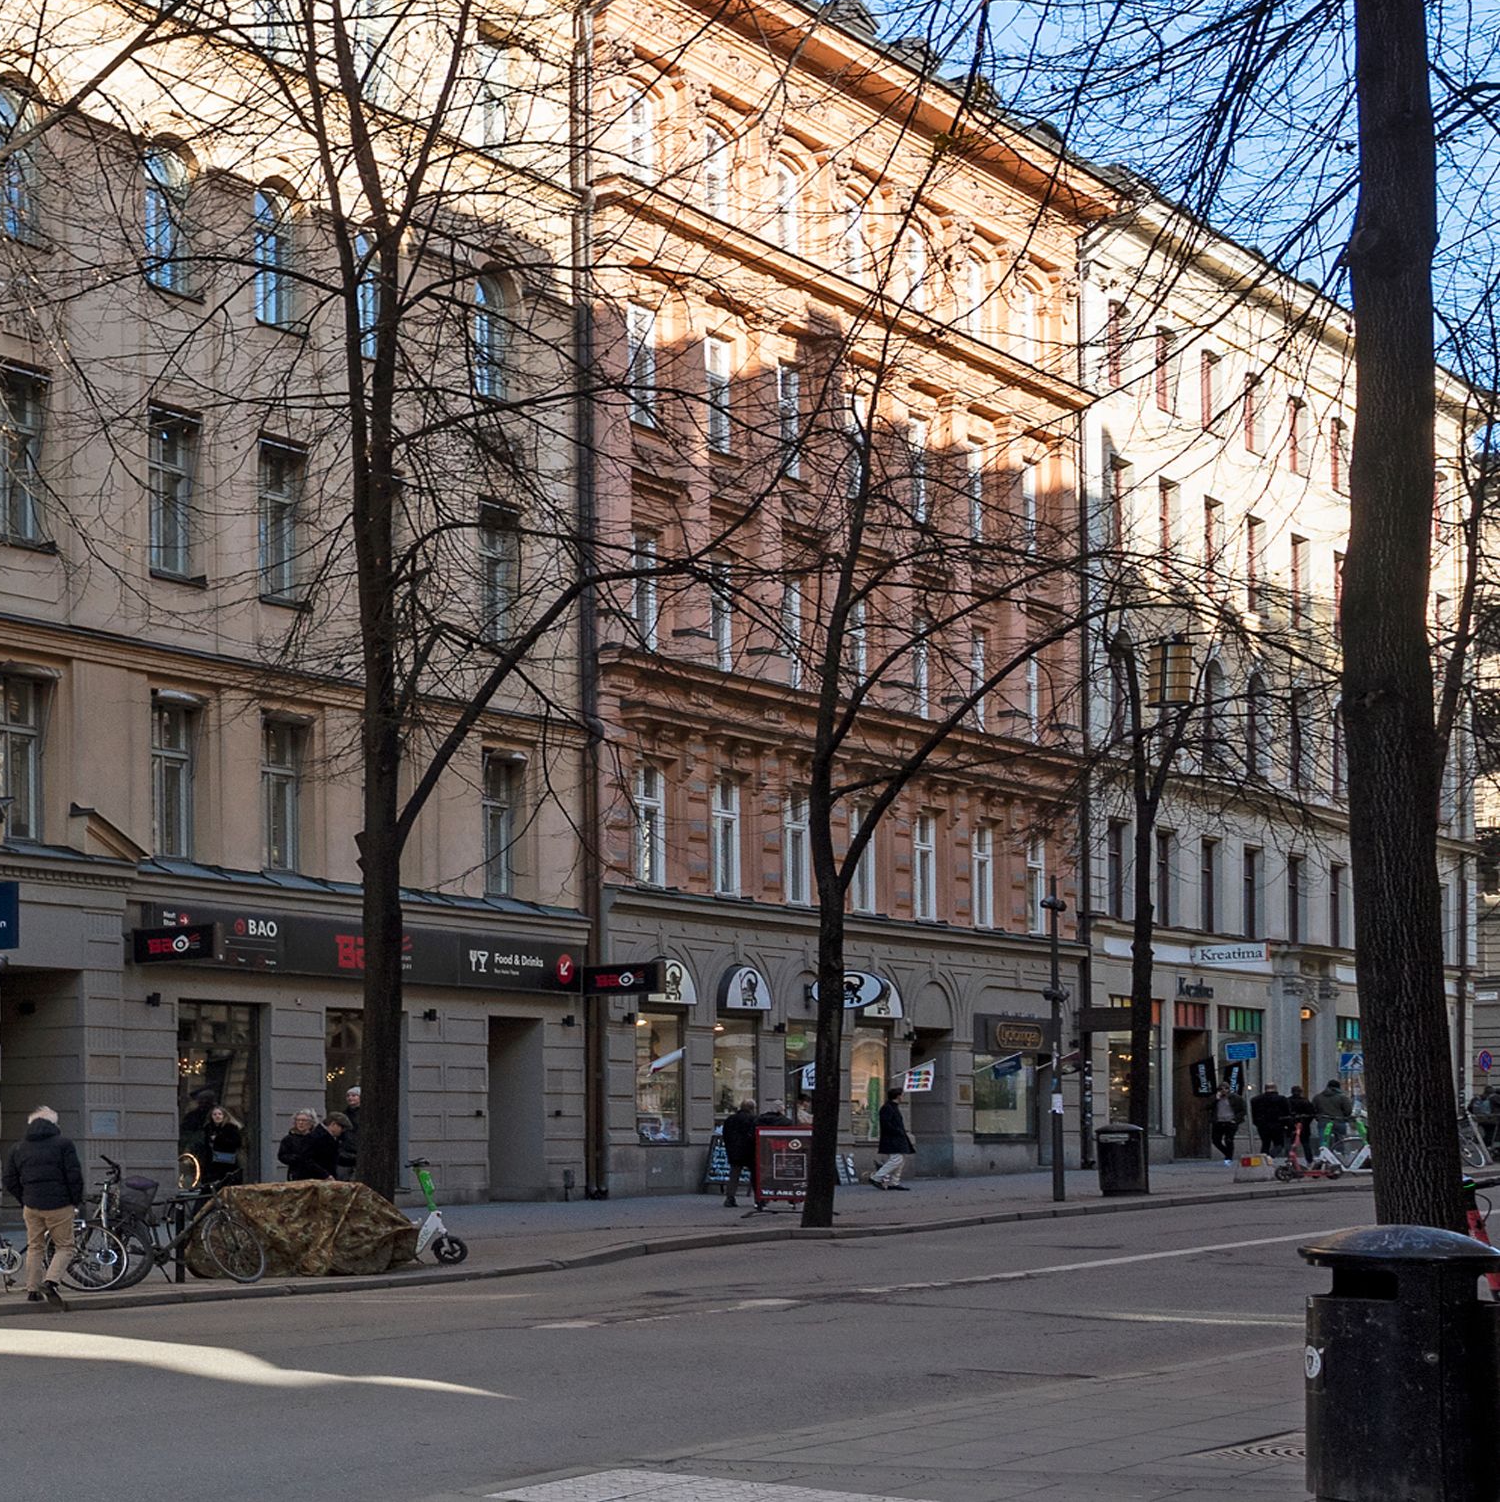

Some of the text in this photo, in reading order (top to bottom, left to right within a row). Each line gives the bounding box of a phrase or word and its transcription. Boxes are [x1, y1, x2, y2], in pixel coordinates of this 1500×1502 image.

[248, 919, 278, 937] BAO
[494, 953, 544, 968] Food & Drinks
[1200, 948, 1264, 961] Kreatima
